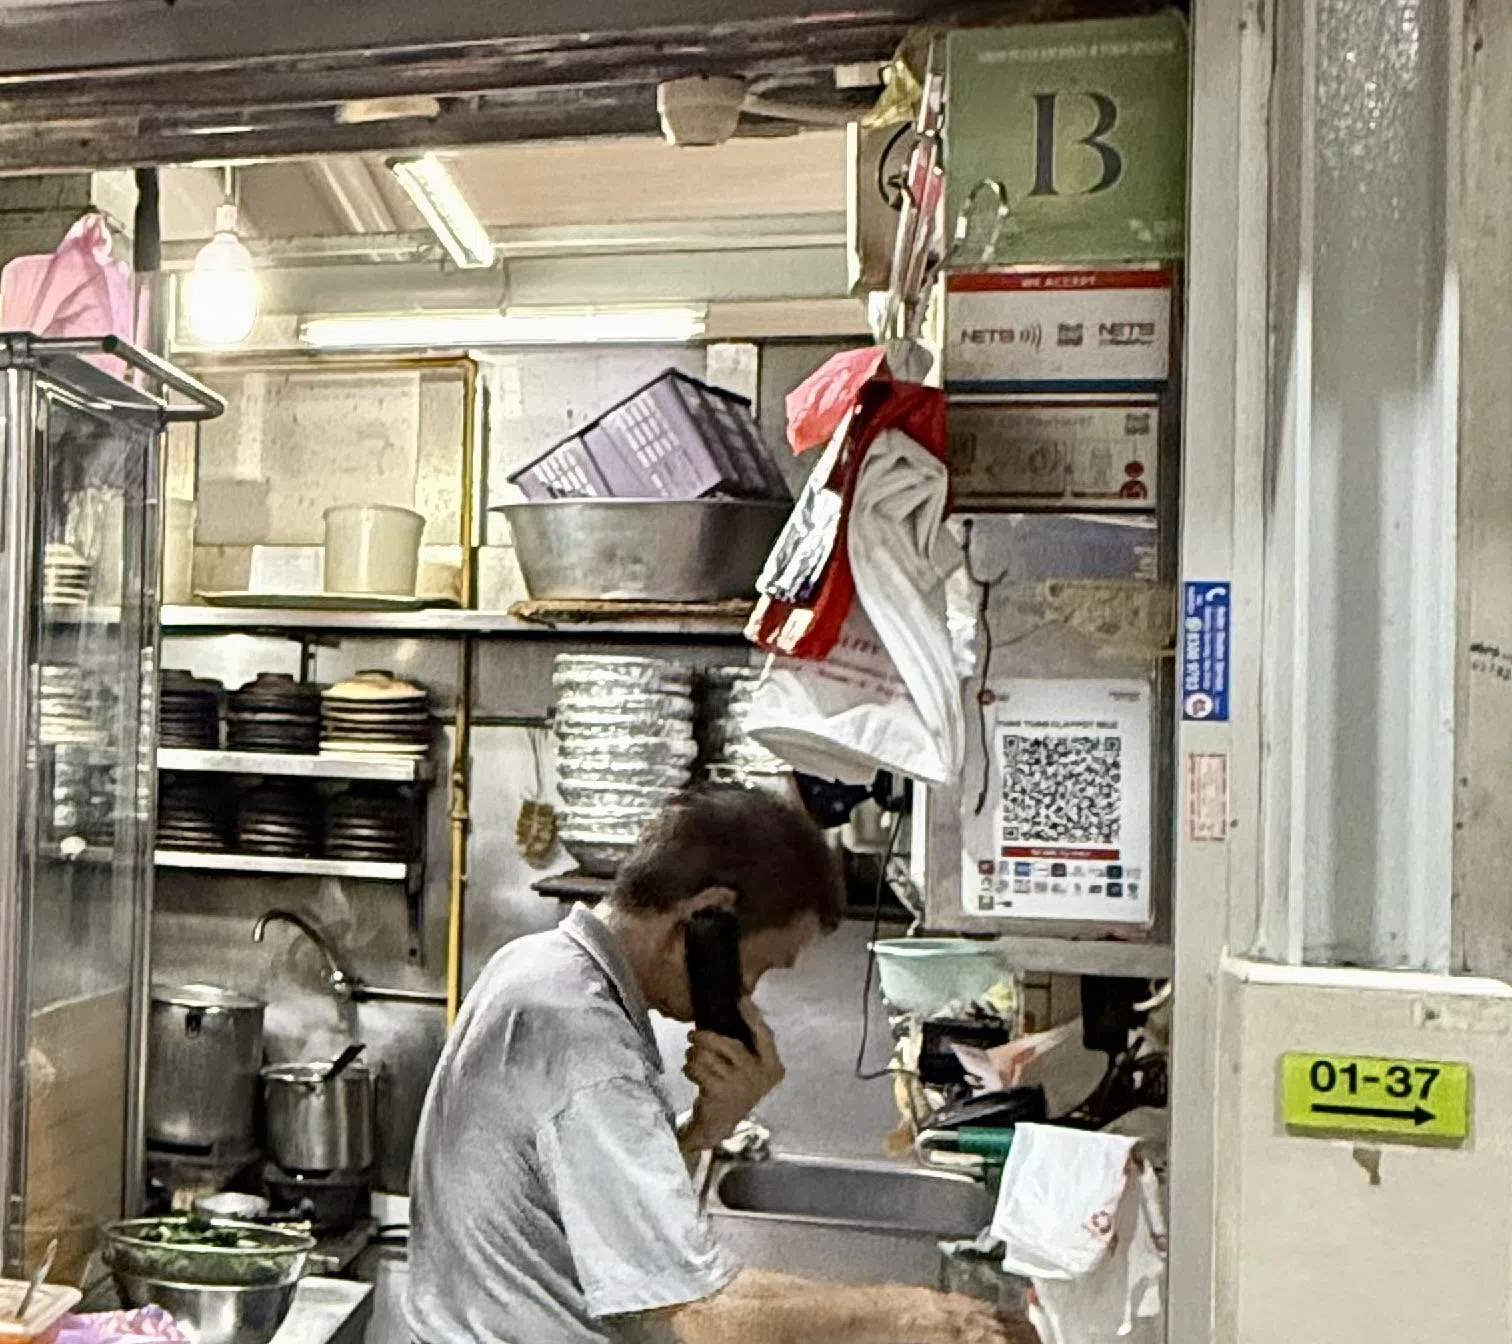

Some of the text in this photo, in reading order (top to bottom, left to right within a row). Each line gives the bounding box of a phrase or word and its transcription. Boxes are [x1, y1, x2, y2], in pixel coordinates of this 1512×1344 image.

[1028, 92, 1124, 196] B
[1044, 275, 1097, 288] ACCEPT
[961, 328, 1015, 345] NETS
[1309, 1060, 1441, 1101] 01-37
